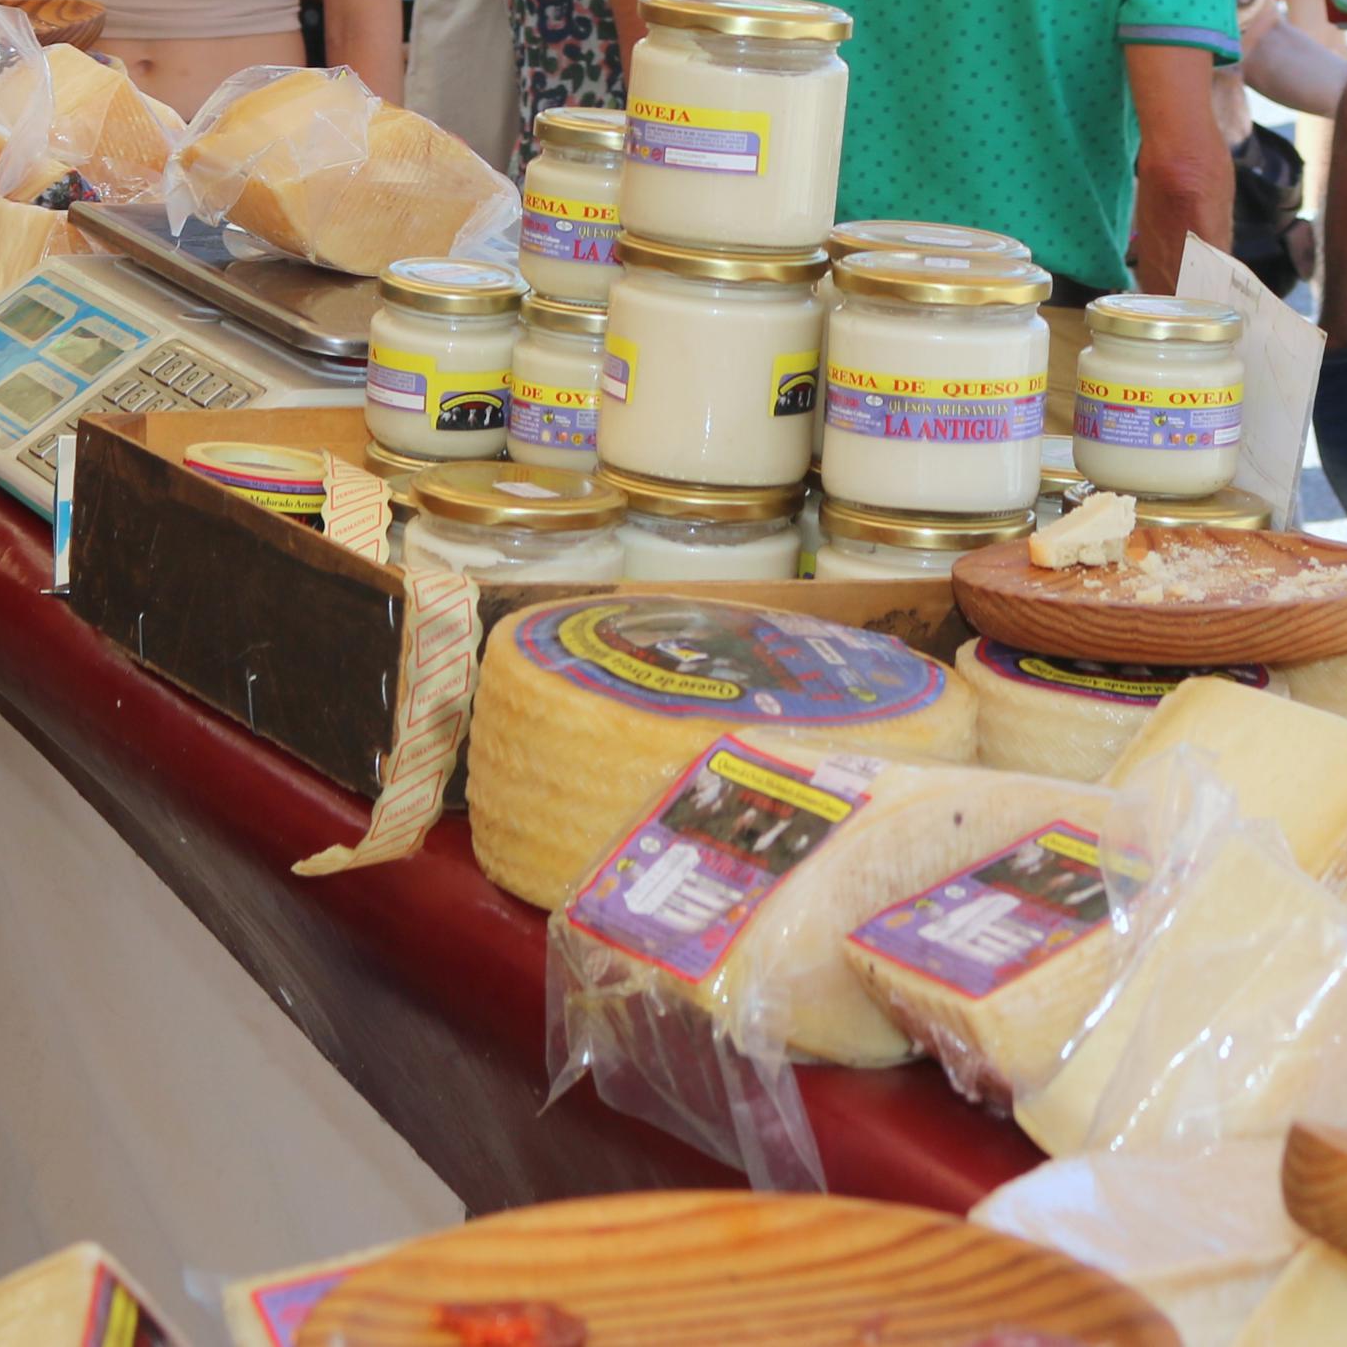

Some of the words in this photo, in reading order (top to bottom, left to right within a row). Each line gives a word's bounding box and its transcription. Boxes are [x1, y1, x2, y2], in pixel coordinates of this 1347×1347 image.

[635, 102, 691, 123] OVEJA
[525, 194, 569, 216] REMA
[583, 205, 615, 221] DE
[573, 239, 600, 262] LA
[522, 385, 543, 401] DE
[555, 391, 600, 404] OVE
[893, 379, 925, 394] DE
[942, 381, 1019, 397] QUESO
[1078, 379, 1109, 398] ESO
[1123, 389, 1153, 403] DE
[1168, 391, 1233, 405] OVEJA
[888, 398, 932, 415] QUESOS
[936, 403, 1009, 417] ARTESANALES
[883, 414, 912, 437] LA
[917, 418, 1011, 441] ANTIGUA
[654, 674, 675, 688] de
[679, 679, 733, 696] Queso
